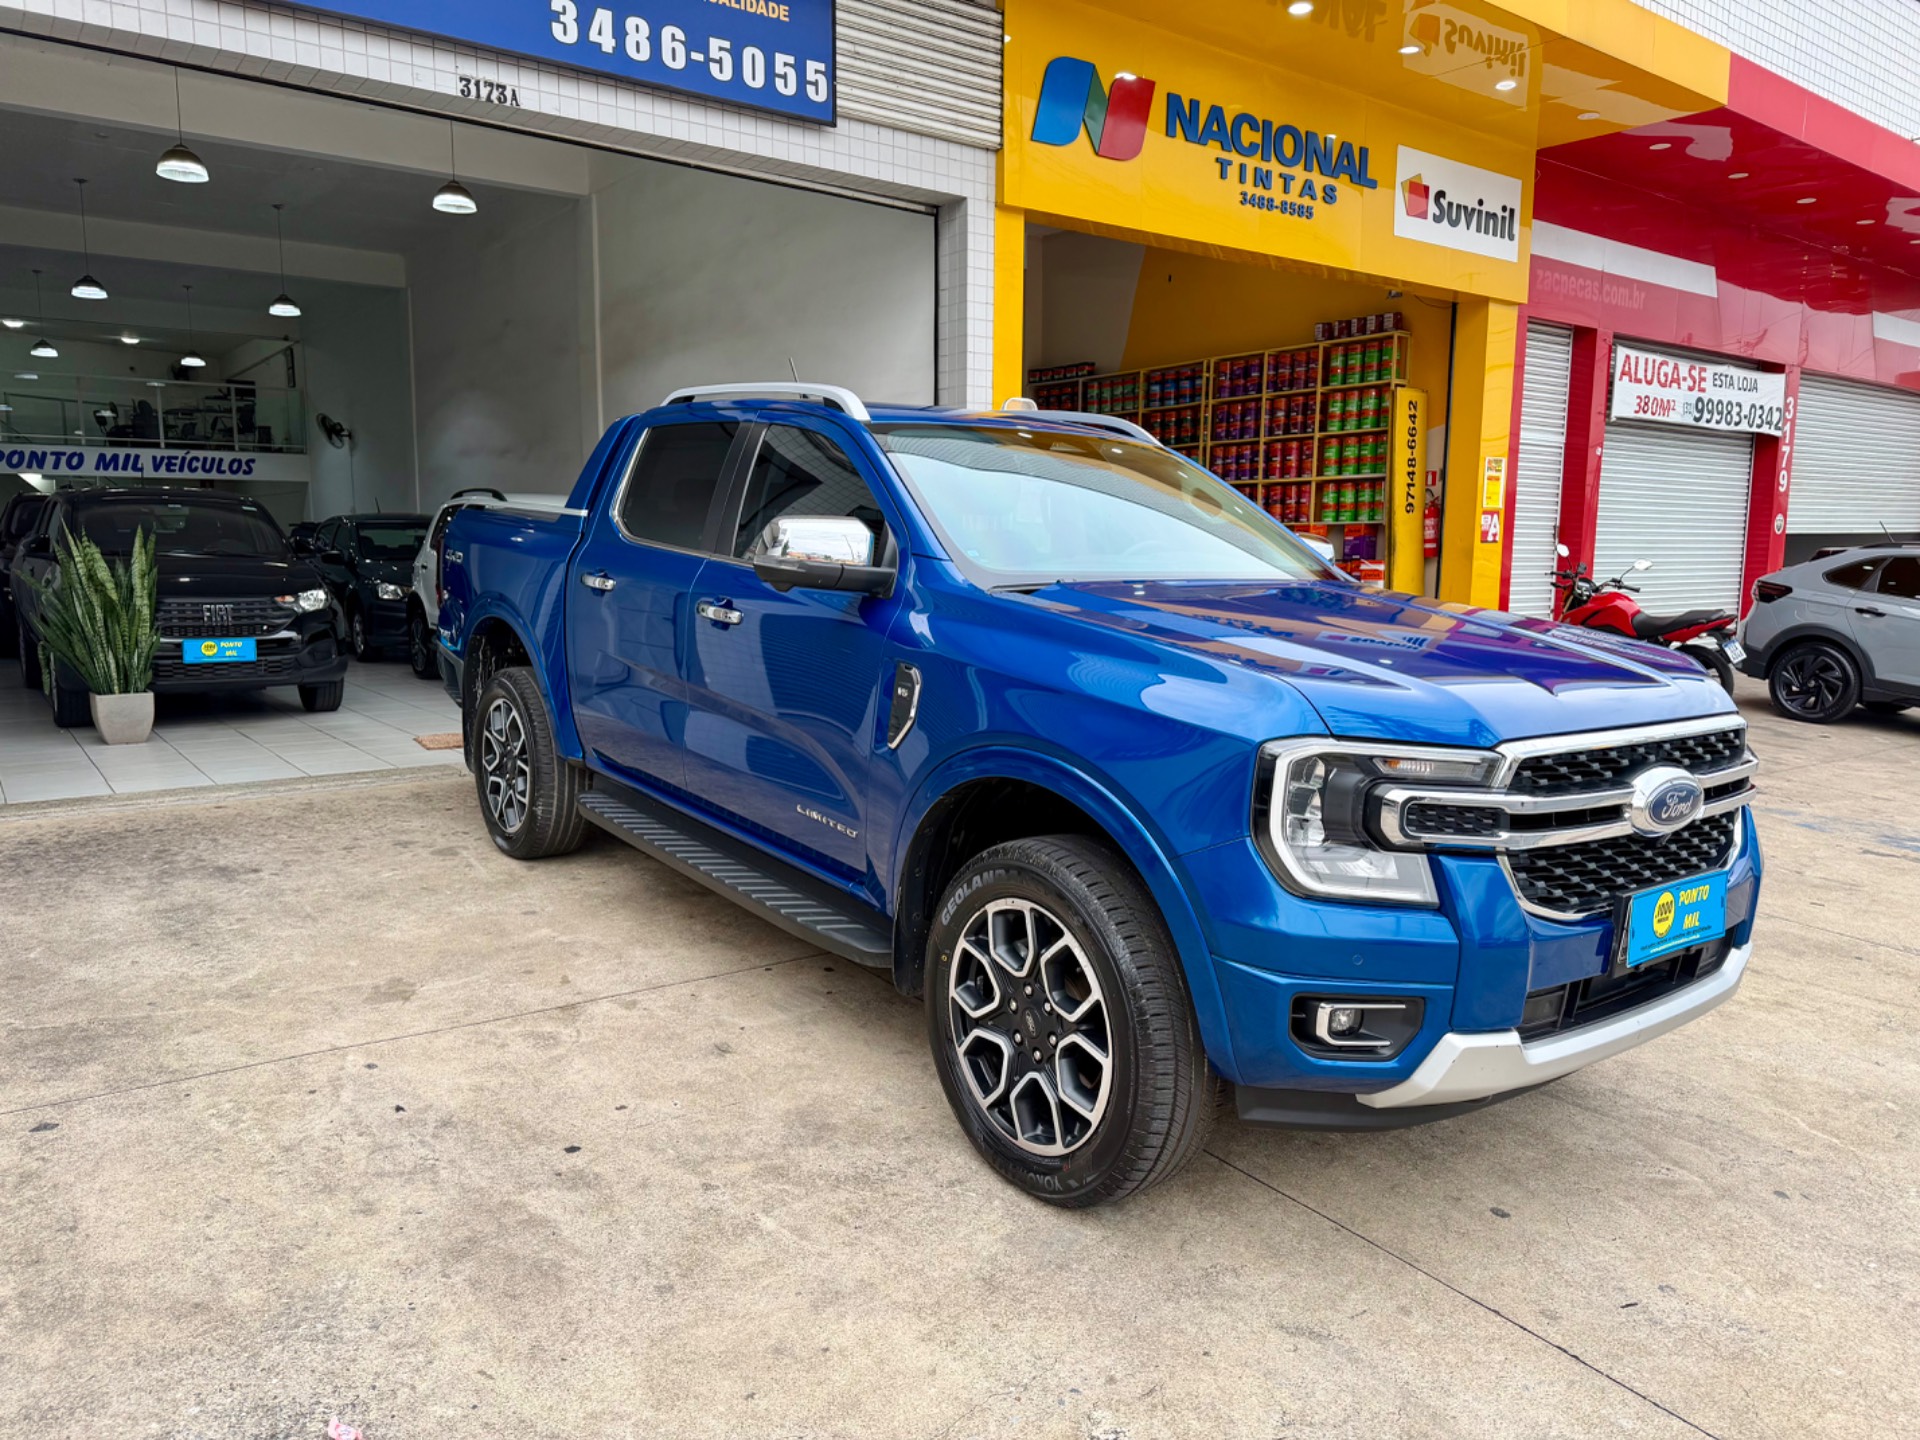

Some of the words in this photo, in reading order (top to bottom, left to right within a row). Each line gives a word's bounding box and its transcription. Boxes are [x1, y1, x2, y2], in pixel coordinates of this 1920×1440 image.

[550, 0, 829, 103] 3486-5055
[458, 75, 521, 108] 3173A
[1165, 92, 1379, 190] NACIONAL
[1215, 156, 1339, 205] TINTAS
[1239, 190, 1315, 221] 3488-8585
[1432, 188, 1516, 243] Suvinil
[1618, 353, 1708, 394] ALUGA-SE
[1712, 371, 1735, 391] ESTA
[1737, 379, 1759, 394] LOJA
[1693, 396, 1783, 431] 99983-0342
[1405, 400, 1418, 514] 97148-6642
[1778, 396, 1795, 493] 3179
[0, 449, 86, 471] ONTO
[94, 452, 144, 472] MIL
[151, 451, 257, 476] VEÍCULOS
[203, 604, 234, 626] FIAT
[796, 803, 859, 839] LIMITED
[1661, 791, 1692, 819] Ford
[1678, 884, 1710, 907] PONTO
[1682, 911, 1700, 930] MIL
